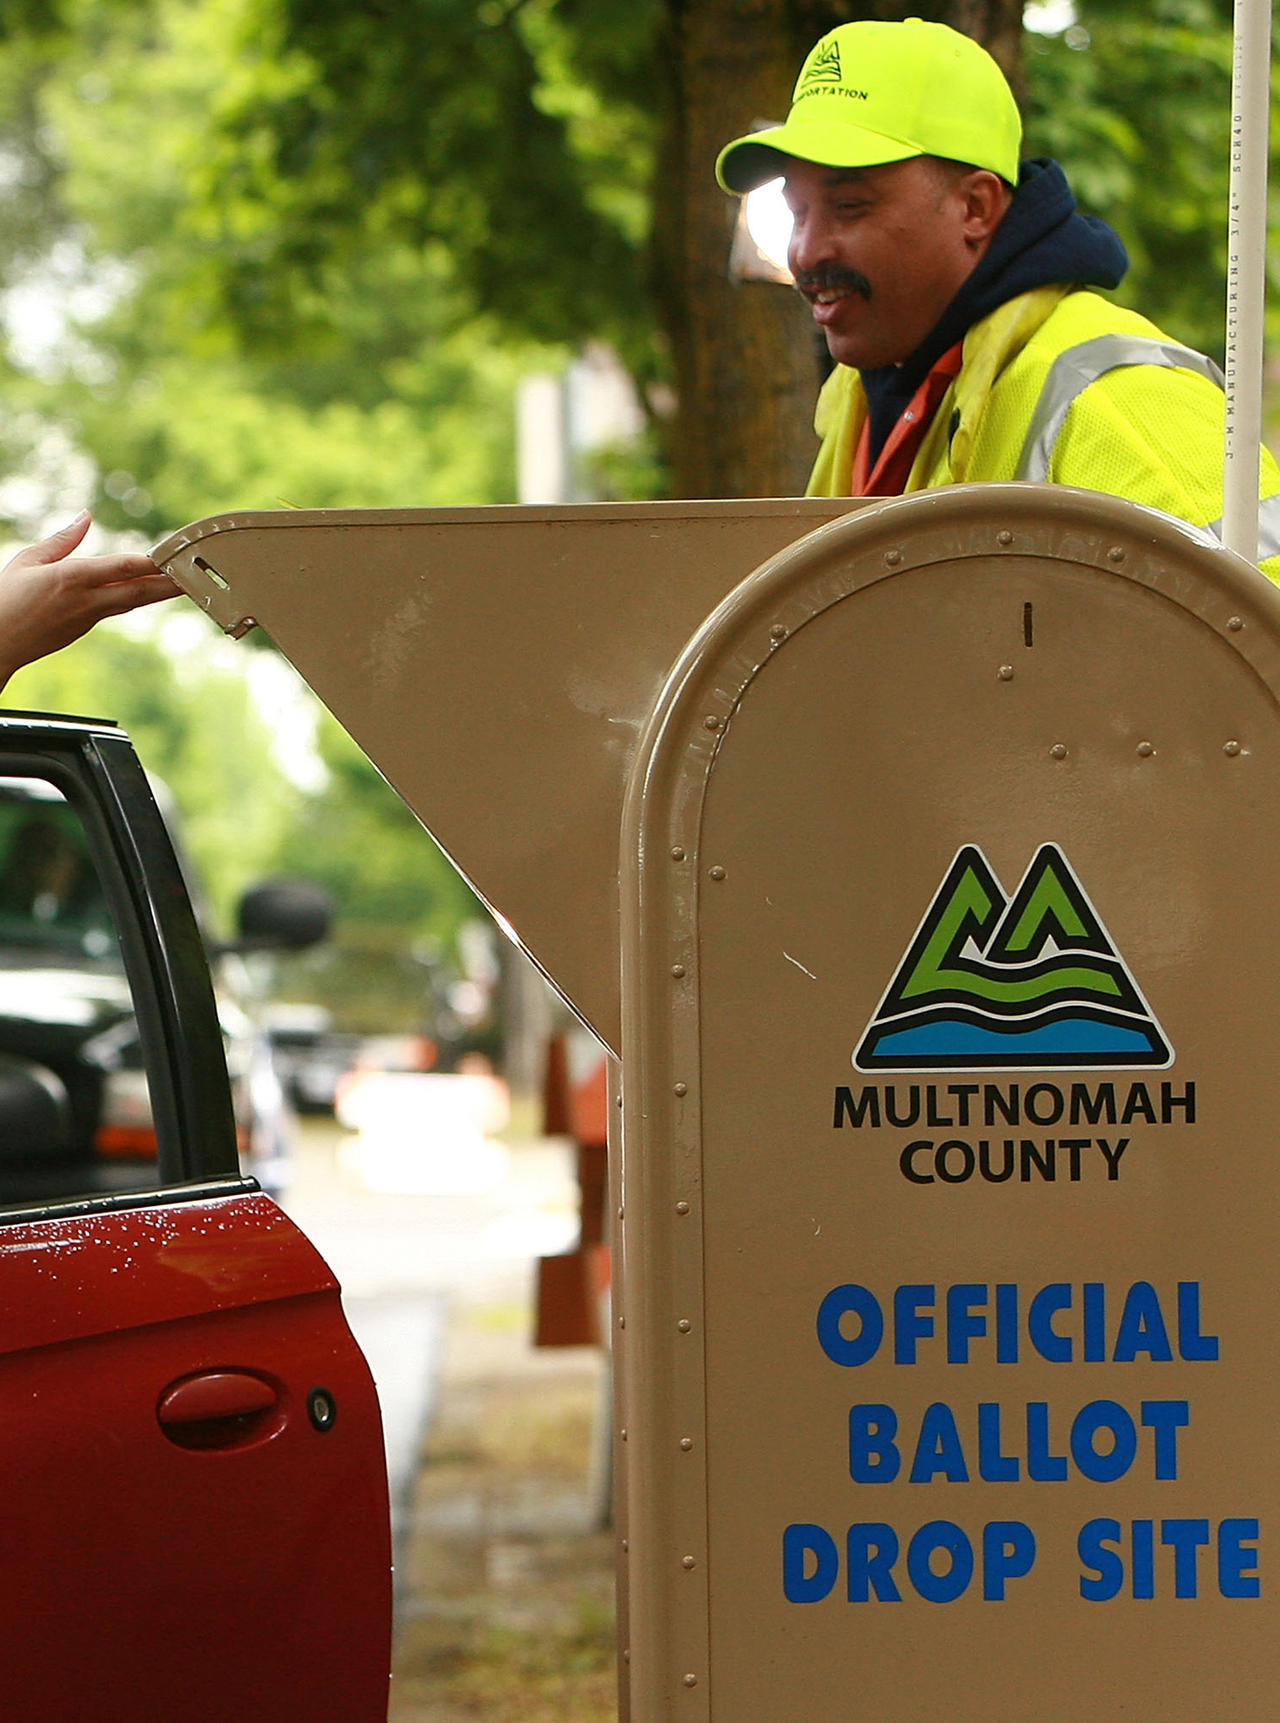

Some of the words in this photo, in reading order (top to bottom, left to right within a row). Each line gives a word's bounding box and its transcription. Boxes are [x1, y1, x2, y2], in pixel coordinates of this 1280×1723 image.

[1234, 115, 1242, 172] SCH40
[1231, 192, 1239, 236] 3/4"
[1227, 254, 1238, 416] MANUFACTURING
[1225, 425, 1234, 459] J-M
[833, 1081, 1197, 1128] MULTNOMAH
[900, 1138, 1130, 1184] COUNTY
[817, 1281, 1219, 1367] OFFICIAL
[849, 1400, 1189, 1483] BALLOT
[783, 1520, 1036, 1603] DROP
[1077, 1518, 1261, 1601] SITE
